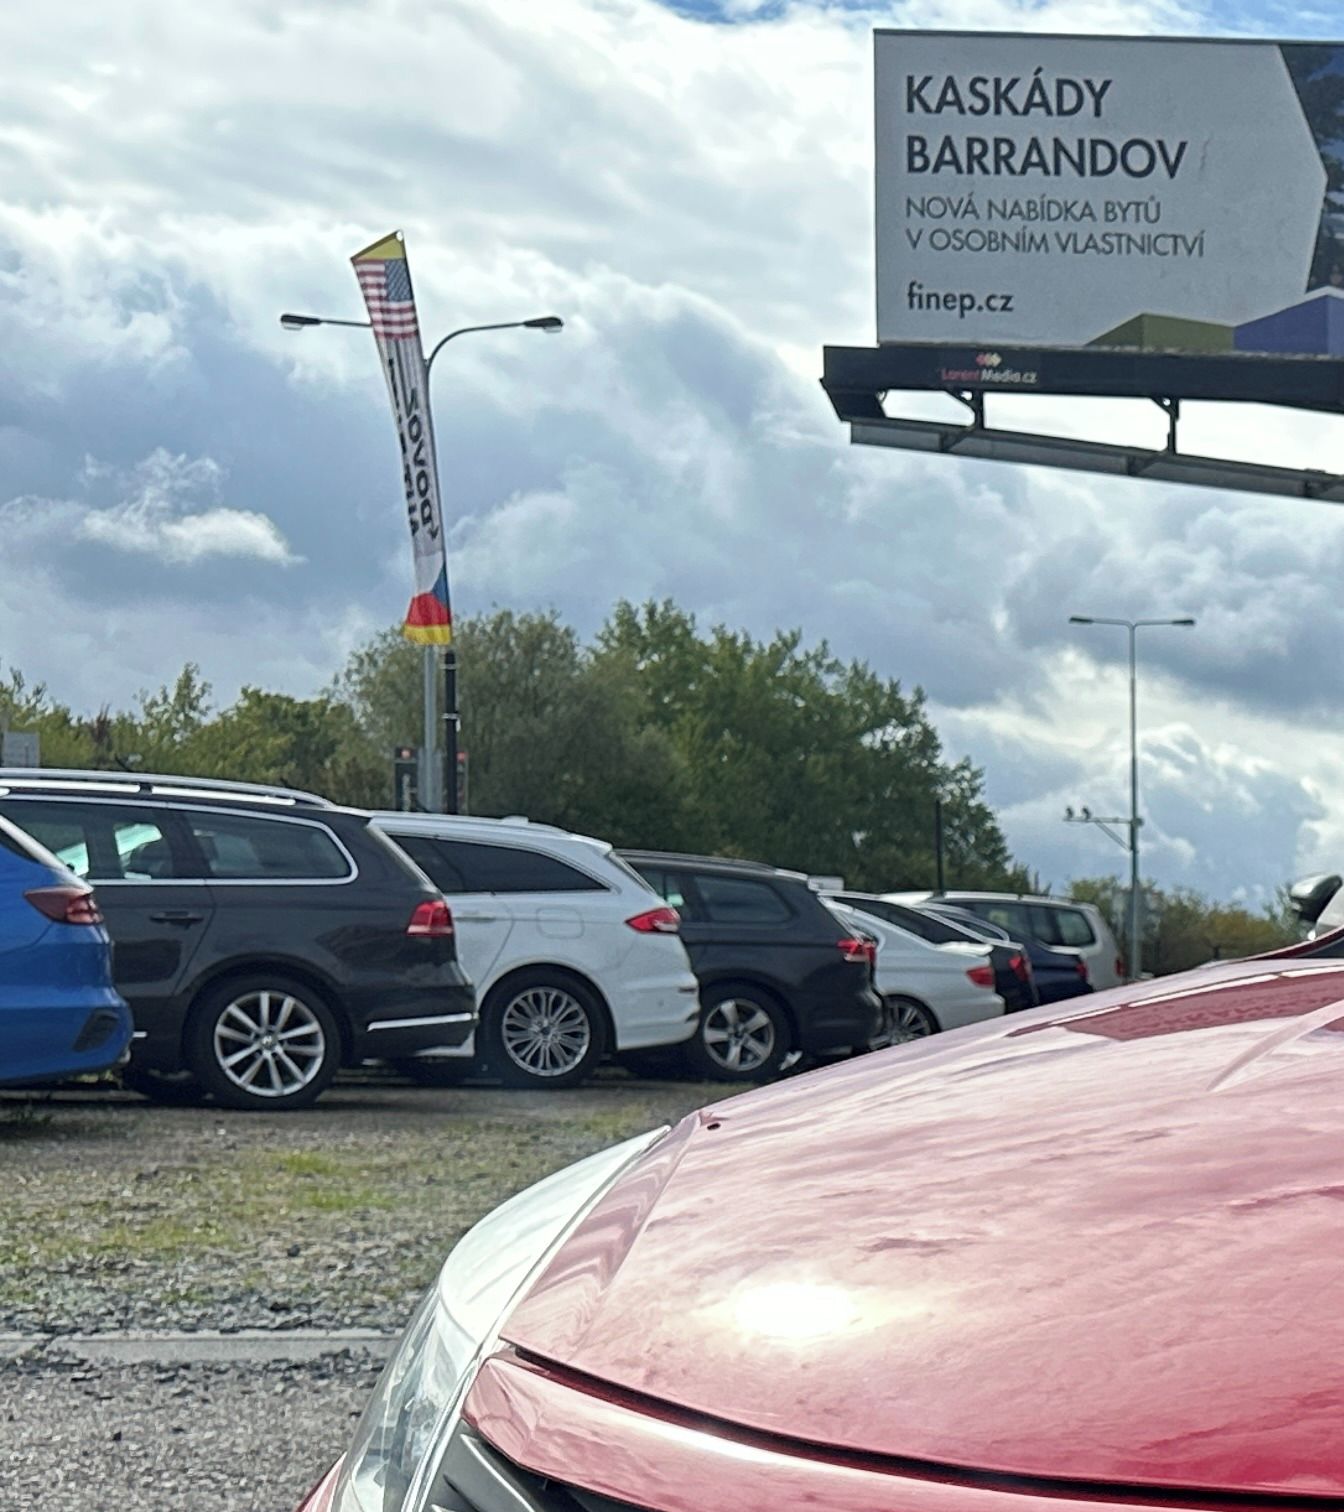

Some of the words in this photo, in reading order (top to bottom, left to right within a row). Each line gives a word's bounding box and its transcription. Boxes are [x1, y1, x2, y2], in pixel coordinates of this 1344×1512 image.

[905, 66, 1113, 118] KASKÁDY
[906, 134, 1189, 179] BARRANDOV
[905, 191, 980, 220] NOVÁ
[987, 193, 1098, 223] NABÍDKA
[1104, 195, 1161, 224] BYTŮ
[905, 228, 923, 250] V
[928, 225, 1050, 253] OSOBNÍM
[1054, 229, 1206, 258] VLASTNICTVÍ
[907, 279, 1014, 319] finep.cz
